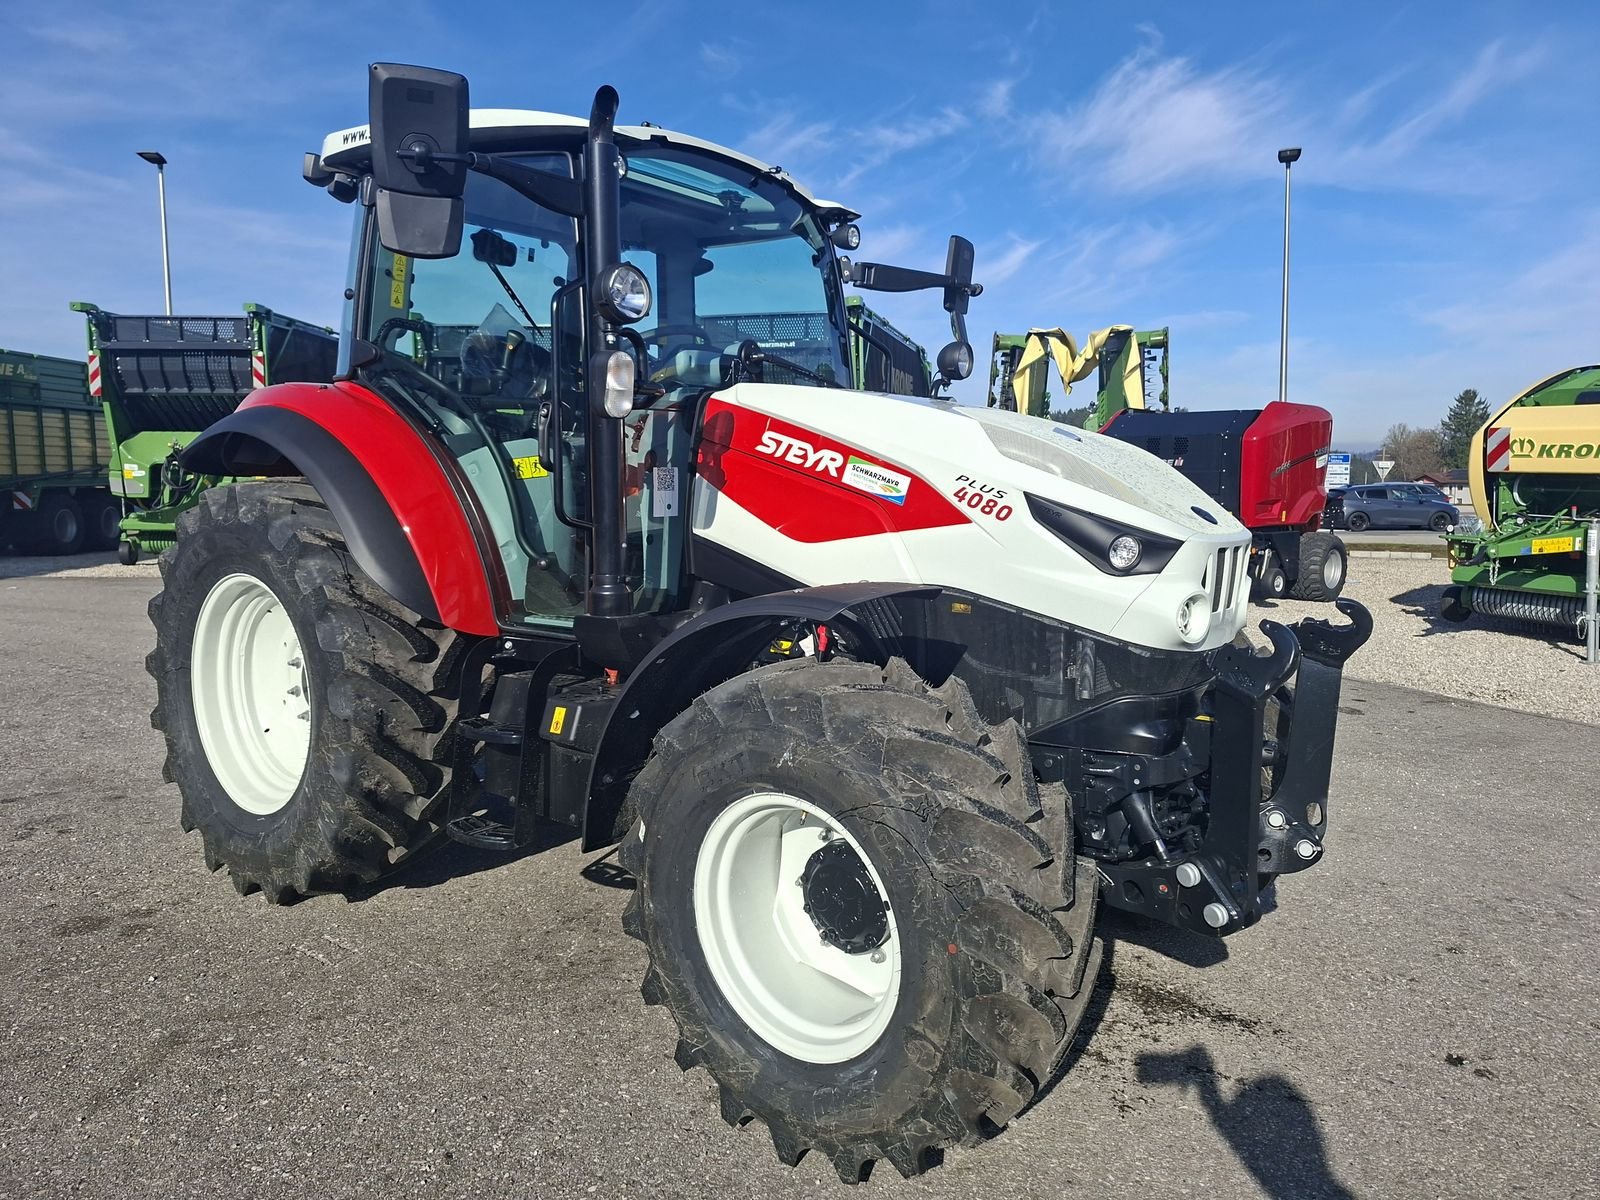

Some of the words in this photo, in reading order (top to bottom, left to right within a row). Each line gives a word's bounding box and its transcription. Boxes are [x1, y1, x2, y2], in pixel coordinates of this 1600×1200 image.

[754, 430, 844, 478] STEYR
[851, 464, 900, 487] SCHWARZMAYR
[955, 475, 1008, 499] PLUS
[953, 486, 1013, 522] 4080
